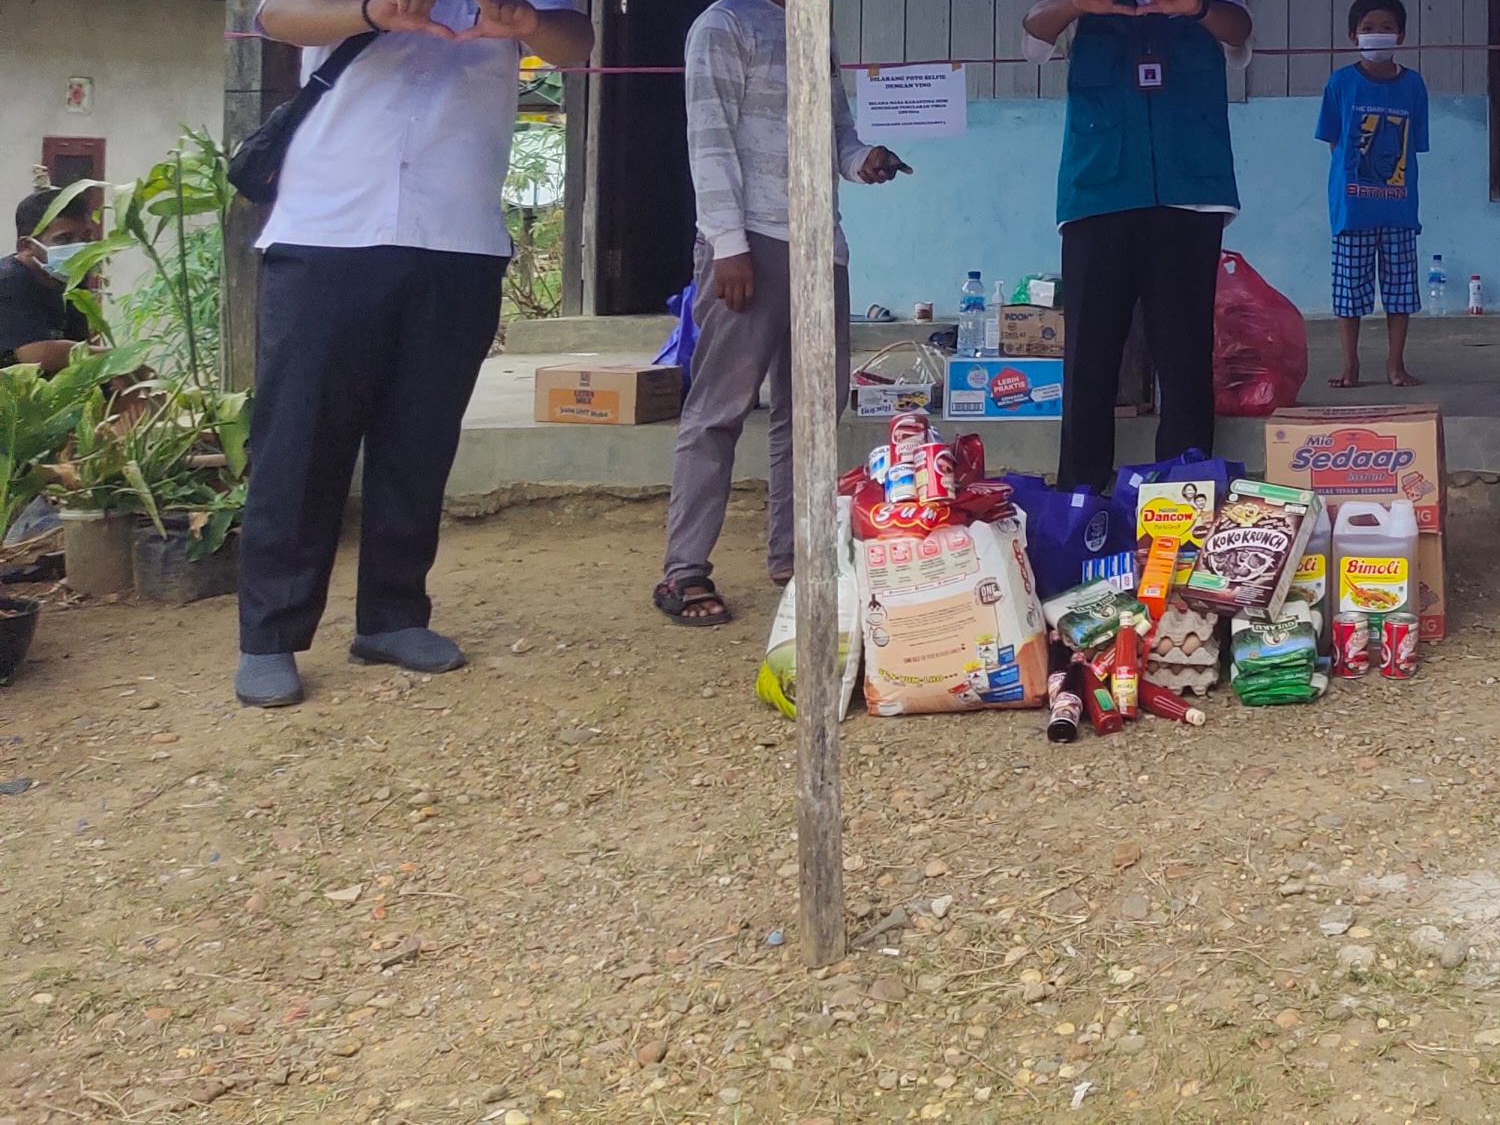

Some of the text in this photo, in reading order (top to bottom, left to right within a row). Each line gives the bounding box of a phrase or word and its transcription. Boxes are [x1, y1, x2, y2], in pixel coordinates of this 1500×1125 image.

[1346, 183, 1408, 199] BATMAN
[993, 381, 1026, 393] PRAKTIS
[997, 376, 1020, 386] LEBIH
[1306, 435, 1334, 448] Mie
[1291, 446, 1415, 473] Sedaap
[1143, 509, 1193, 522] Dancow
[1241, 529, 1287, 549] KRUNCH
[1296, 557, 1318, 572] oli
[1346, 559, 1401, 574] Bimoli
